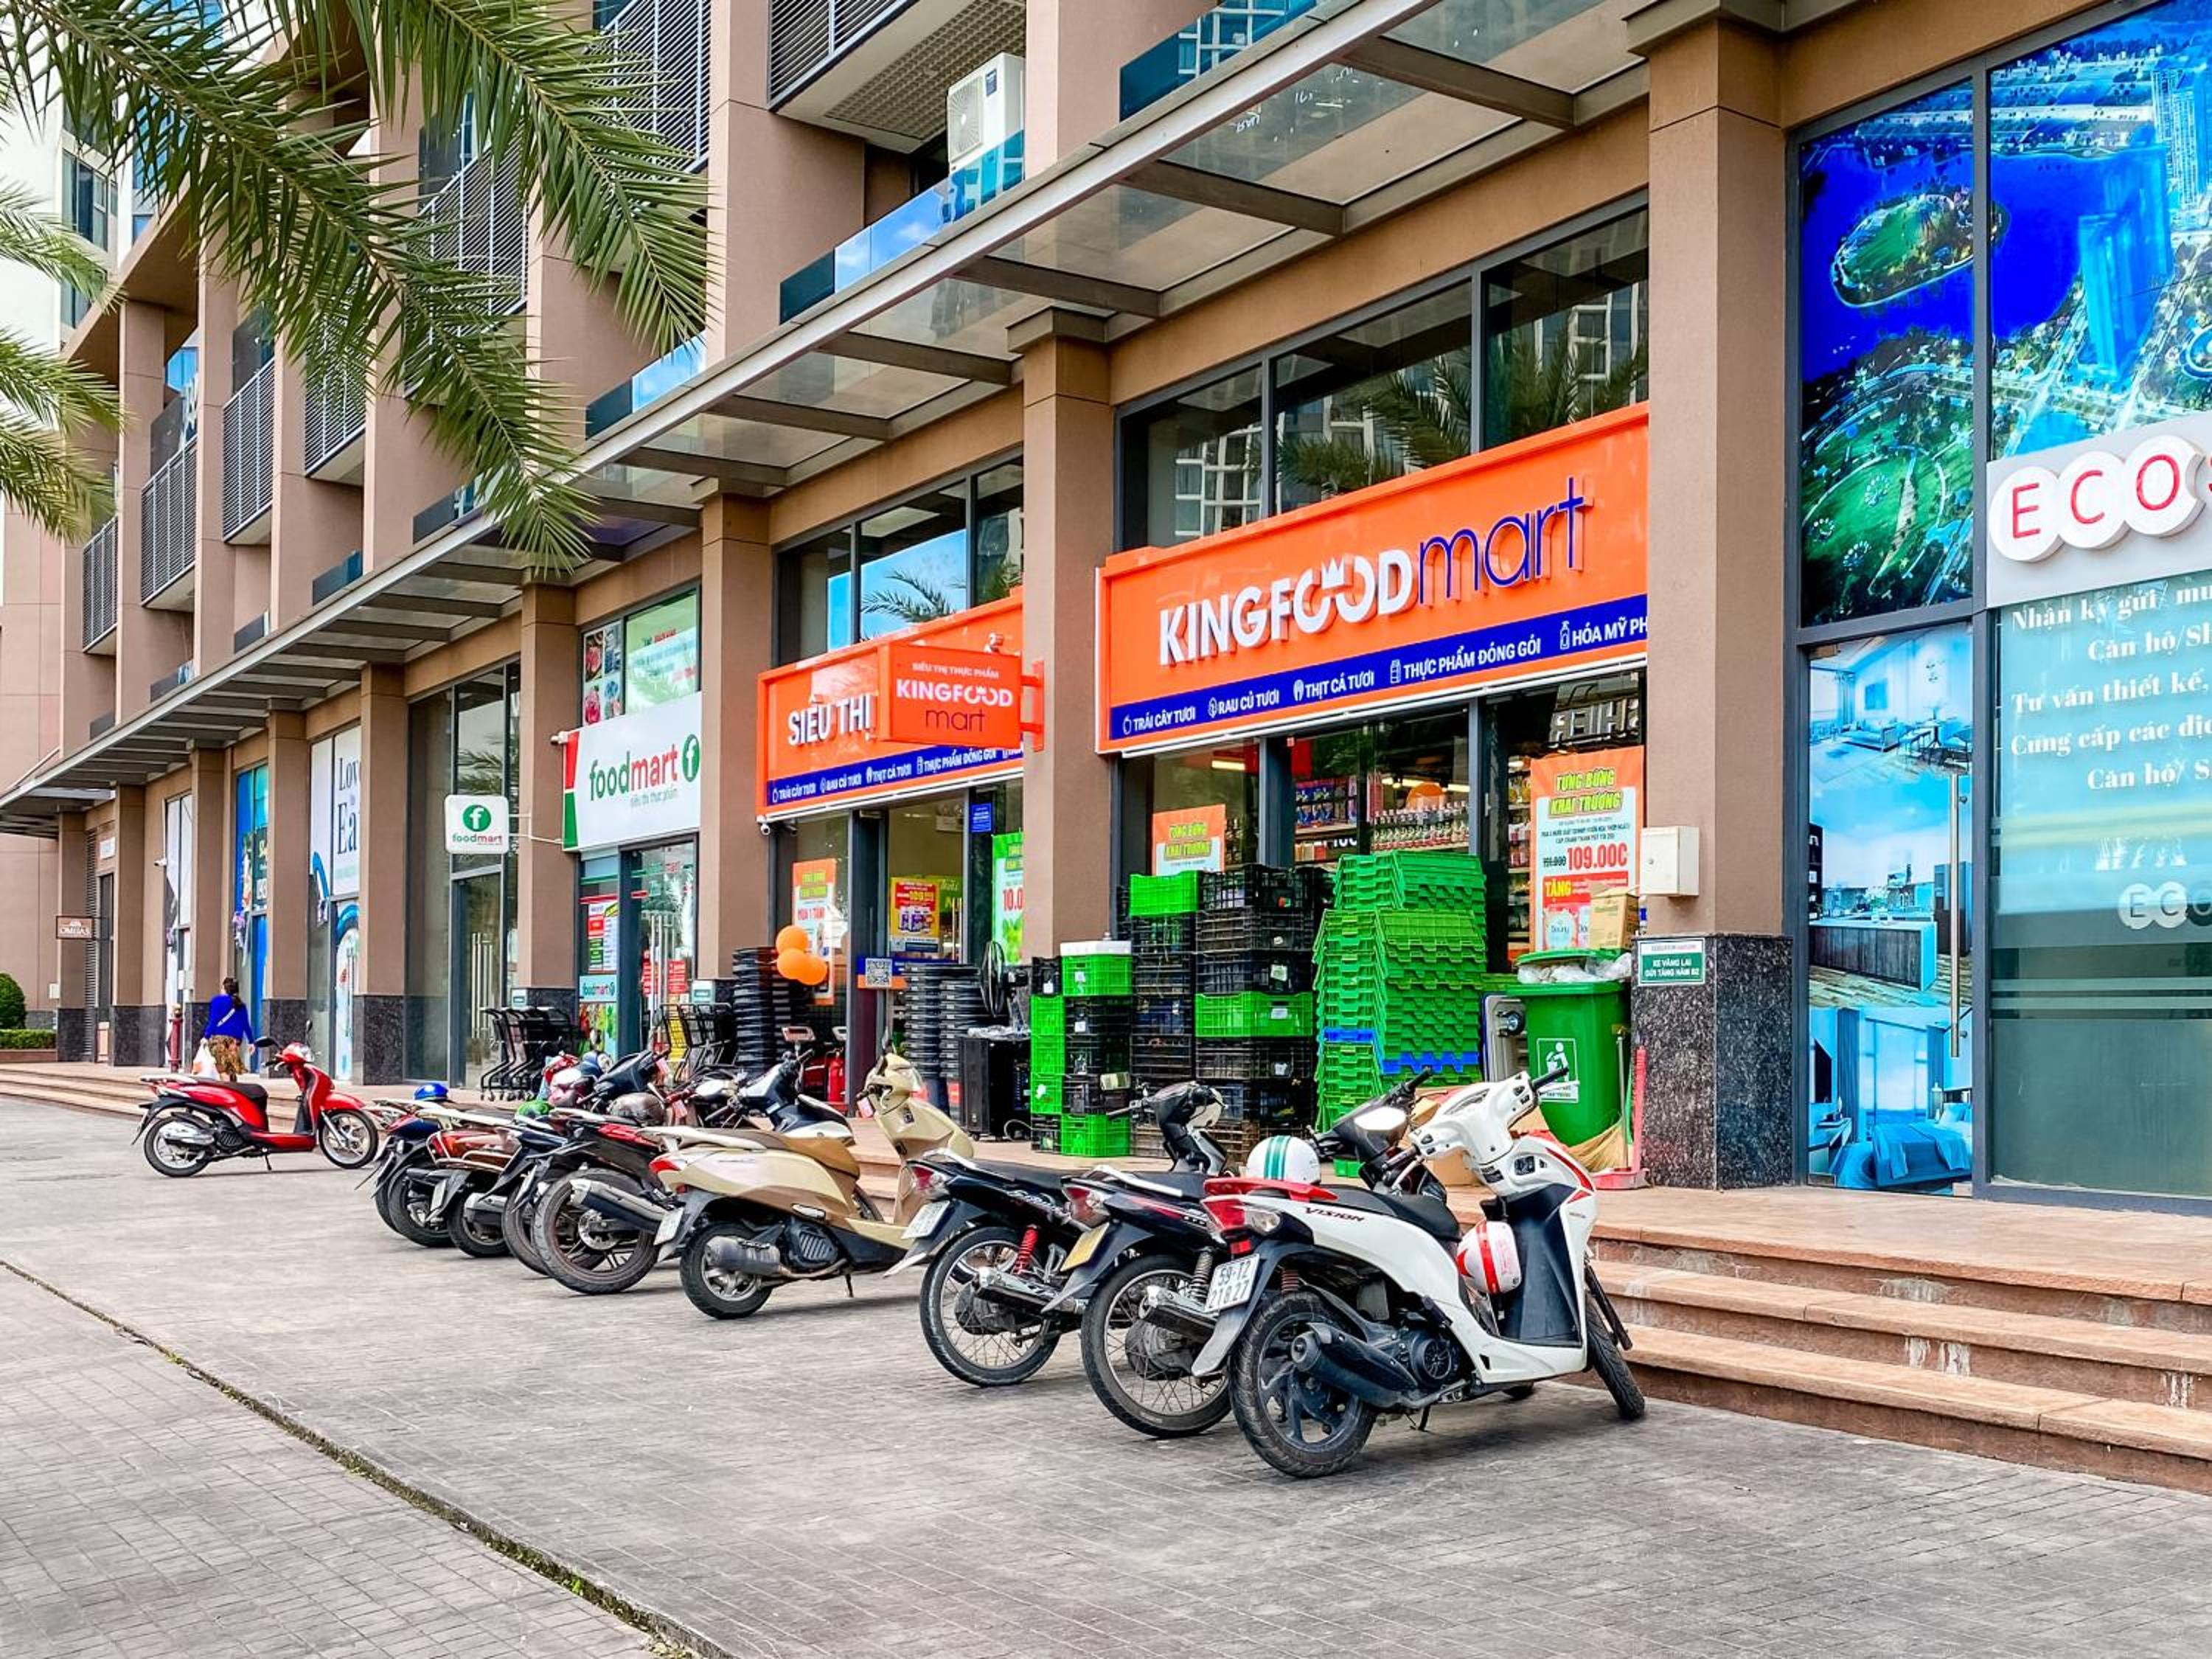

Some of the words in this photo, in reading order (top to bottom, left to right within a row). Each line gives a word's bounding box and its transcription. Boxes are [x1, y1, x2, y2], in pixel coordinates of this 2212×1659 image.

[2011, 452, 2212, 539] ECO
[2012, 607, 2071, 630] Nhận
[1133, 712, 1154, 731] TRÁI
[1154, 708, 1173, 727] CÂY
[1172, 706, 1197, 724] TƯƠI
[1217, 698, 1239, 715] RAU
[1239, 689, 1254, 712] CỦ
[1256, 689, 1280, 707] TƯƠI
[1304, 678, 1329, 700] THỊT
[1332, 672, 1347, 694] CÁ
[1349, 669, 1375, 689] TƯƠI
[1403, 658, 1437, 681] THỰC
[1439, 646, 1475, 672] PHẨM
[1478, 641, 1515, 665] ĐÓNG
[1517, 633, 1541, 658] GÓI
[1572, 622, 1601, 647] HÓA
[1604, 616, 1627, 641] MỸ
[2052, 684, 2094, 709] vấn
[2103, 673, 2162, 703] thiết
[897, 678, 1013, 707] KINGFOOD
[788, 693, 832, 746] SIÊU
[836, 693, 872, 741] THỊ
[925, 709, 985, 732] mart
[2011, 733, 2072, 757] Cung
[2079, 724, 2121, 751] cấp
[2129, 720, 2170, 741] các
[338, 757, 362, 791] Lov
[590, 743, 678, 801] foodmart
[452, 832, 503, 843] foodmart
